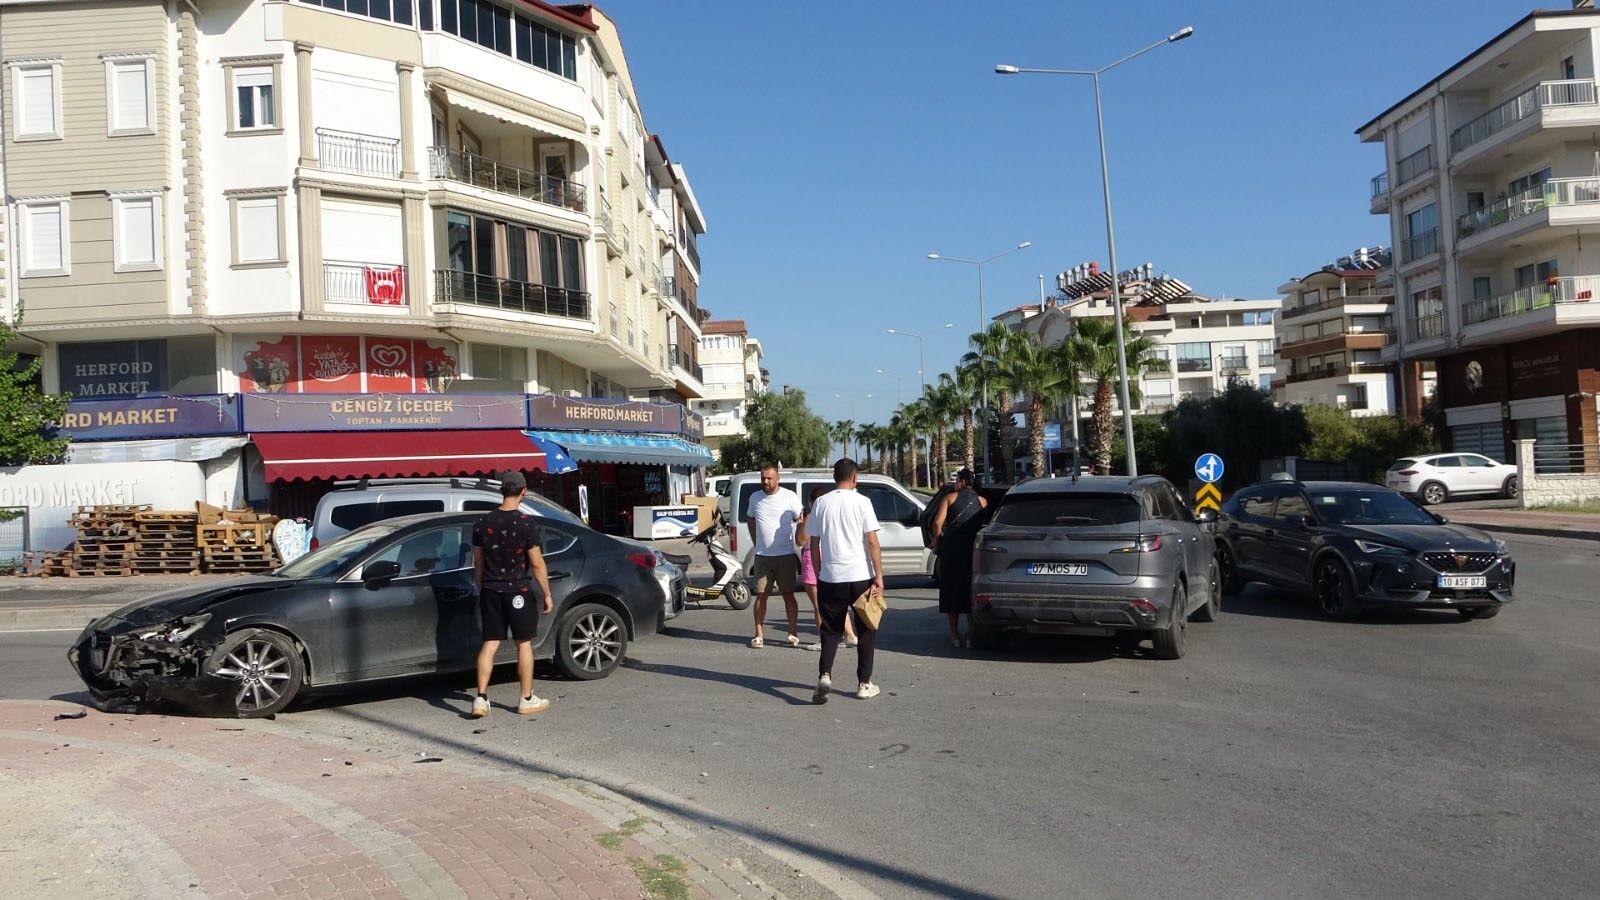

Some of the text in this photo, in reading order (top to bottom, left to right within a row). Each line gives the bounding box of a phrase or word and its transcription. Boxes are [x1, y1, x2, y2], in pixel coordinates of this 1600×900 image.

[75, 361, 153, 377] HERFORD
[80, 381, 150, 396] MARKET
[331, 398, 454, 415] CENGİZ İÇECEK
[565, 406, 654, 422] HERFORD MARKET
[97, 407, 178, 426] MARKET
[346, 417, 382, 425] TOPTAN
[390, 416, 443, 425] PARAKENDE
[50, 479, 138, 508] MARKET
[1032, 564, 1087, 574] 07 MOS 70
